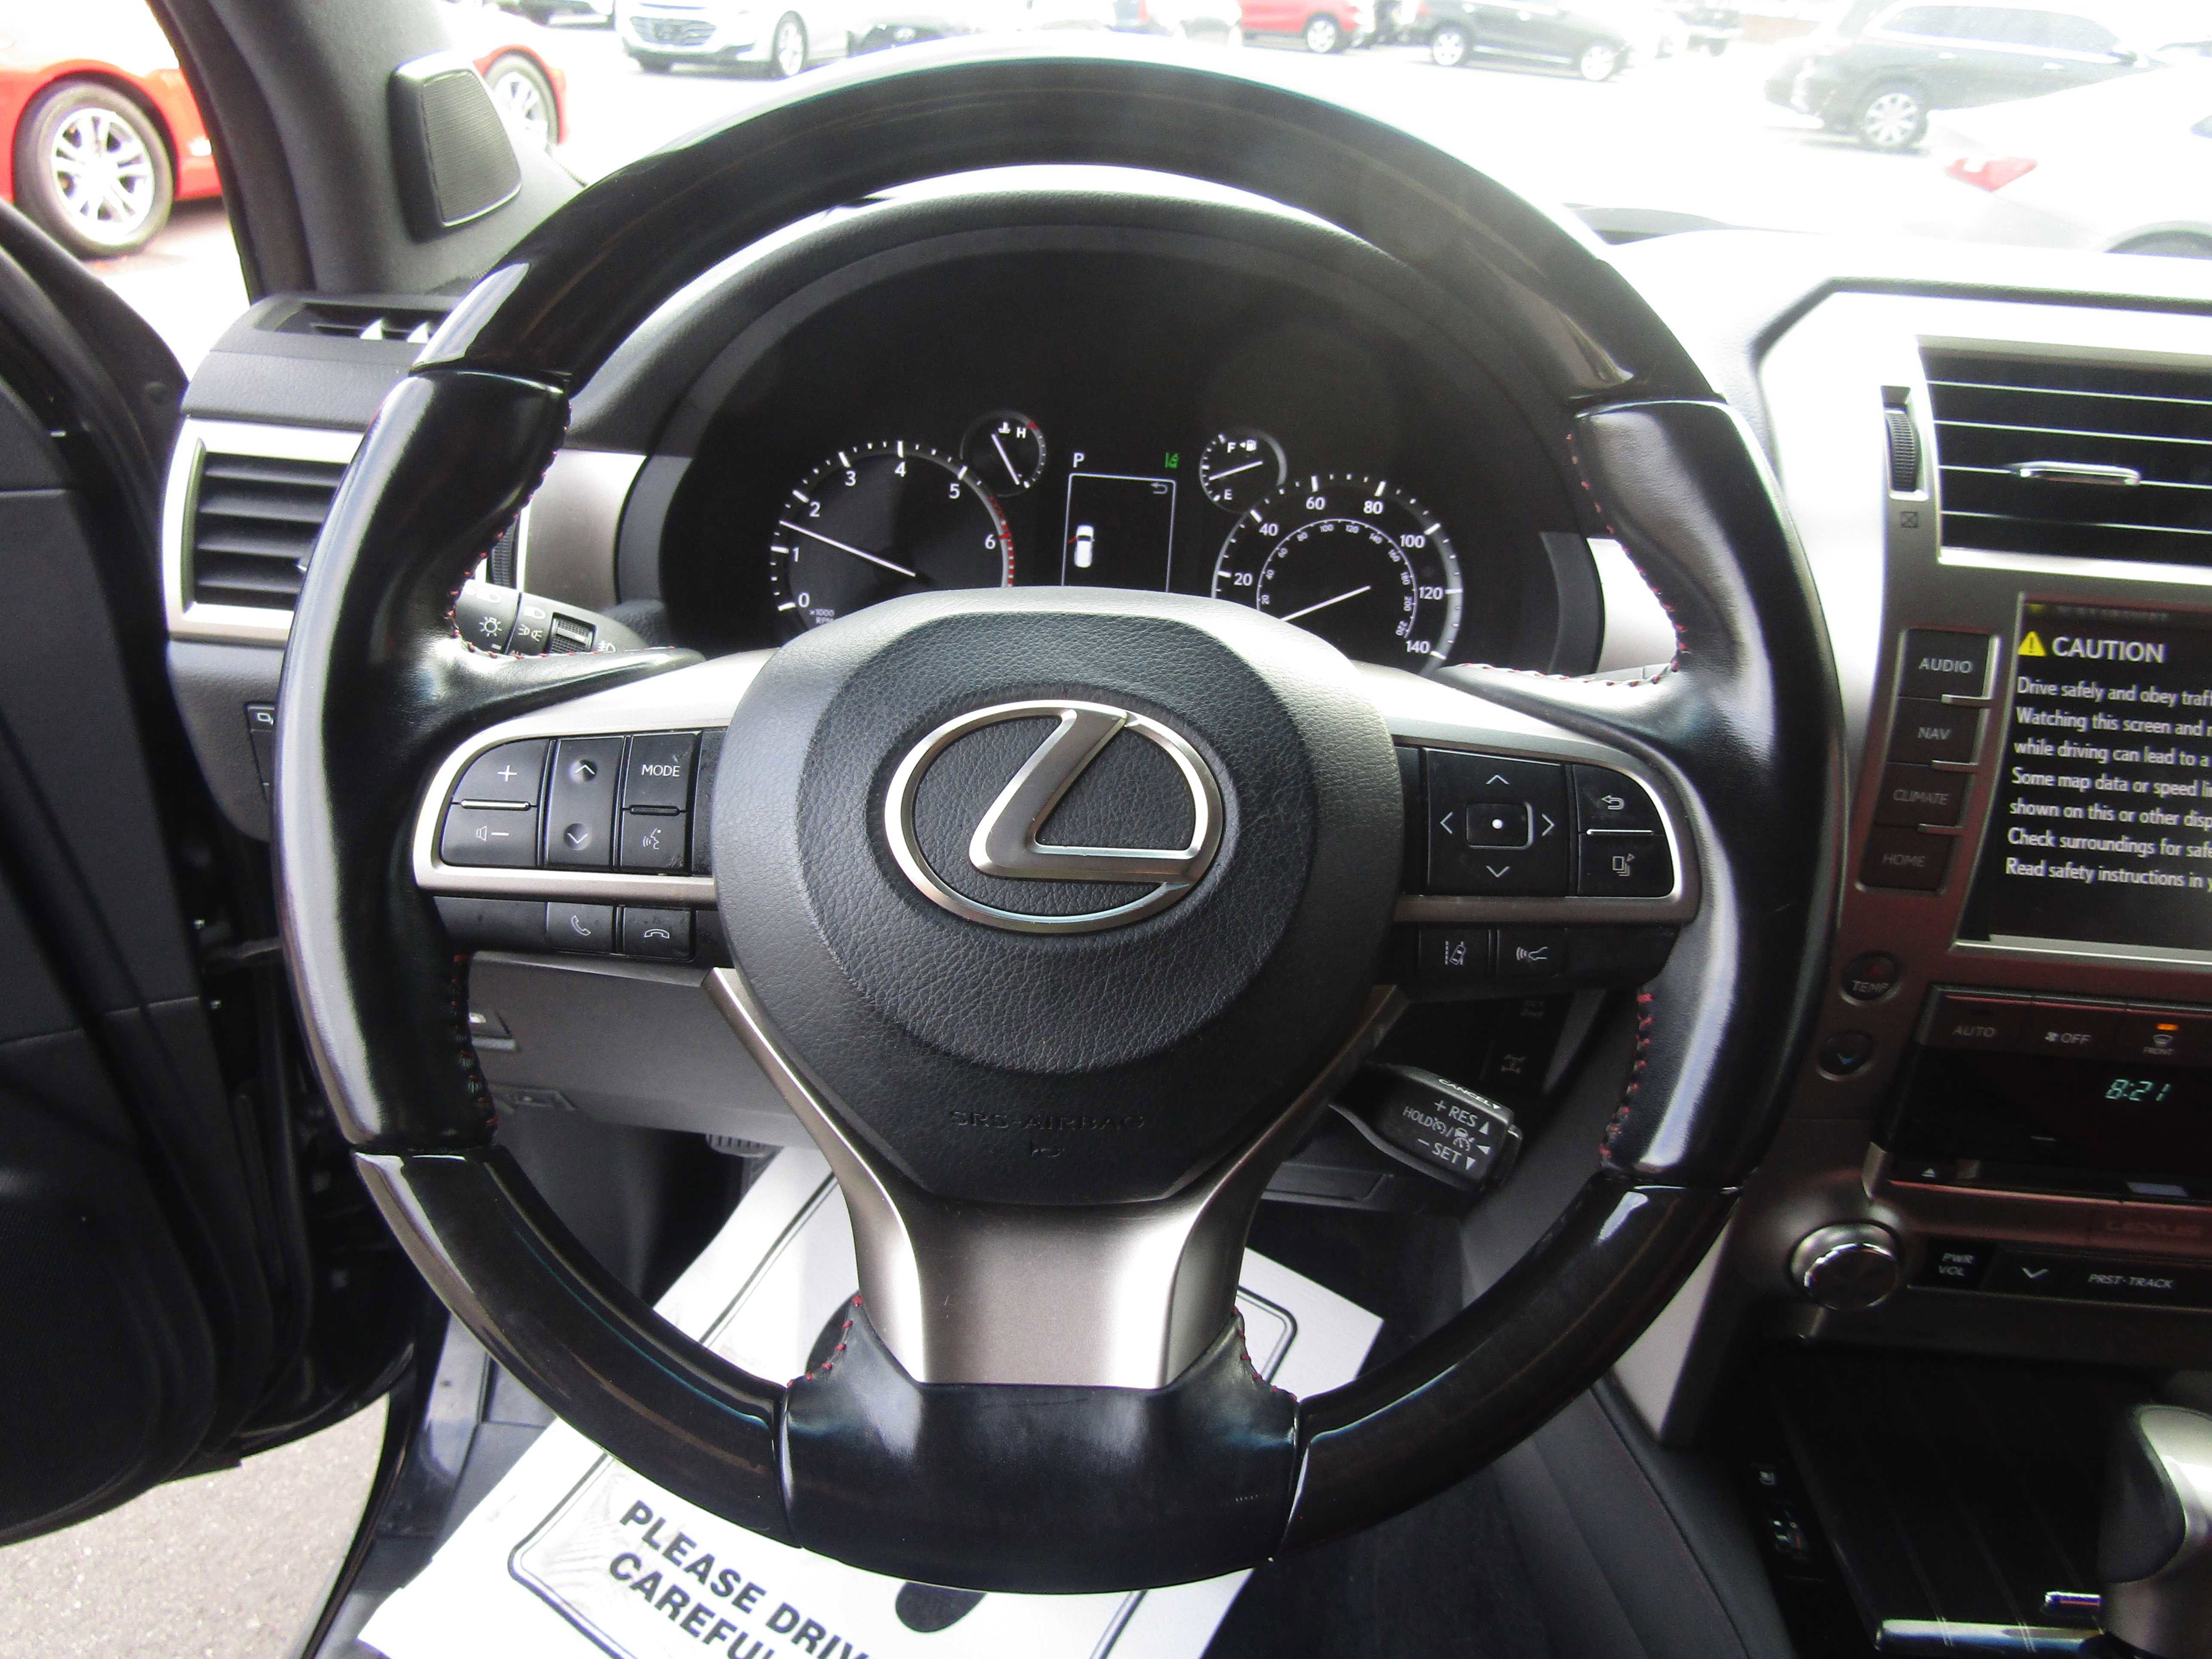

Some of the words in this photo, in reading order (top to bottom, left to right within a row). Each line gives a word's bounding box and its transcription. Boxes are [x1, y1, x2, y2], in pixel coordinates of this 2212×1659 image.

[1016, 426, 1027, 439] H
[1227, 442, 1237, 454] F
[1073, 452, 1085, 468] P
[894, 461, 907, 477] 4
[844, 470, 857, 486] 3
[948, 483, 961, 500] 5
[1224, 488, 1233, 501] E
[809, 501, 821, 518] 2
[1306, 496, 1326, 510] 60
[1363, 500, 1384, 515] 80
[1258, 523, 1279, 537] 40
[984, 534, 996, 550] 6
[1399, 534, 1426, 549] 100
[792, 546, 800, 562] 1
[1234, 572, 1253, 587] 20
[798, 592, 811, 608] 0
[1418, 586, 1444, 601] 120
[1405, 640, 1431, 654] 140
[2052, 636, 2165, 663] CAUTION
[1918, 657, 1975, 674] AUDIO
[2017, 675, 2058, 696] Drive
[2061, 680, 2105, 703] safely
[2108, 684, 2137, 702] and
[2140, 685, 2179, 708] obey
[2015, 706, 2088, 733] Watching
[2091, 711, 2119, 730] this
[2122, 719, 2172, 734] screen
[2174, 719, 2205, 737] and
[1917, 726, 1951, 740] NAV
[2013, 736, 2056, 756] while
[2057, 739, 2111, 765] driving
[2112, 749, 2140, 763] can
[2143, 745, 2177, 765] lead
[2179, 751, 2197, 767] to
[641, 763, 682, 778] MODE
[2011, 766, 2055, 787] Some
[2058, 776, 2093, 793] map
[2095, 772, 2130, 792] data
[2133, 781, 2150, 793] or
[2152, 779, 2198, 799] speed
[1893, 789, 1951, 805] CLIMATE
[2009, 796, 2061, 817] shown
[2063, 806, 2086, 819] on
[2087, 802, 2116, 821] this
[2118, 810, 2137, 823] or
[2139, 807, 2181, 826] other
[2008, 826, 2058, 848] Check
[2060, 835, 2157, 858] surroundings
[2160, 837, 2183, 855] for
[2005, 857, 2048, 877] Read
[2048, 861, 2098, 884] safety
[2097, 865, 2186, 887] instructions
[2189, 872, 2206, 889] in
[1952, 1026, 1996, 1038] AUTO
[2060, 1032, 2092, 1045] OFF
[1438, 1078, 1492, 1107] CANCEL
[2105, 1079, 2172, 1102] 8:21
[1942, 1252, 1975, 1264] PWR
[1939, 1266, 1965, 1276] VOL
[620, 1499, 767, 1614] PLEASE
[609, 1552, 775, 1659] CAREFU
